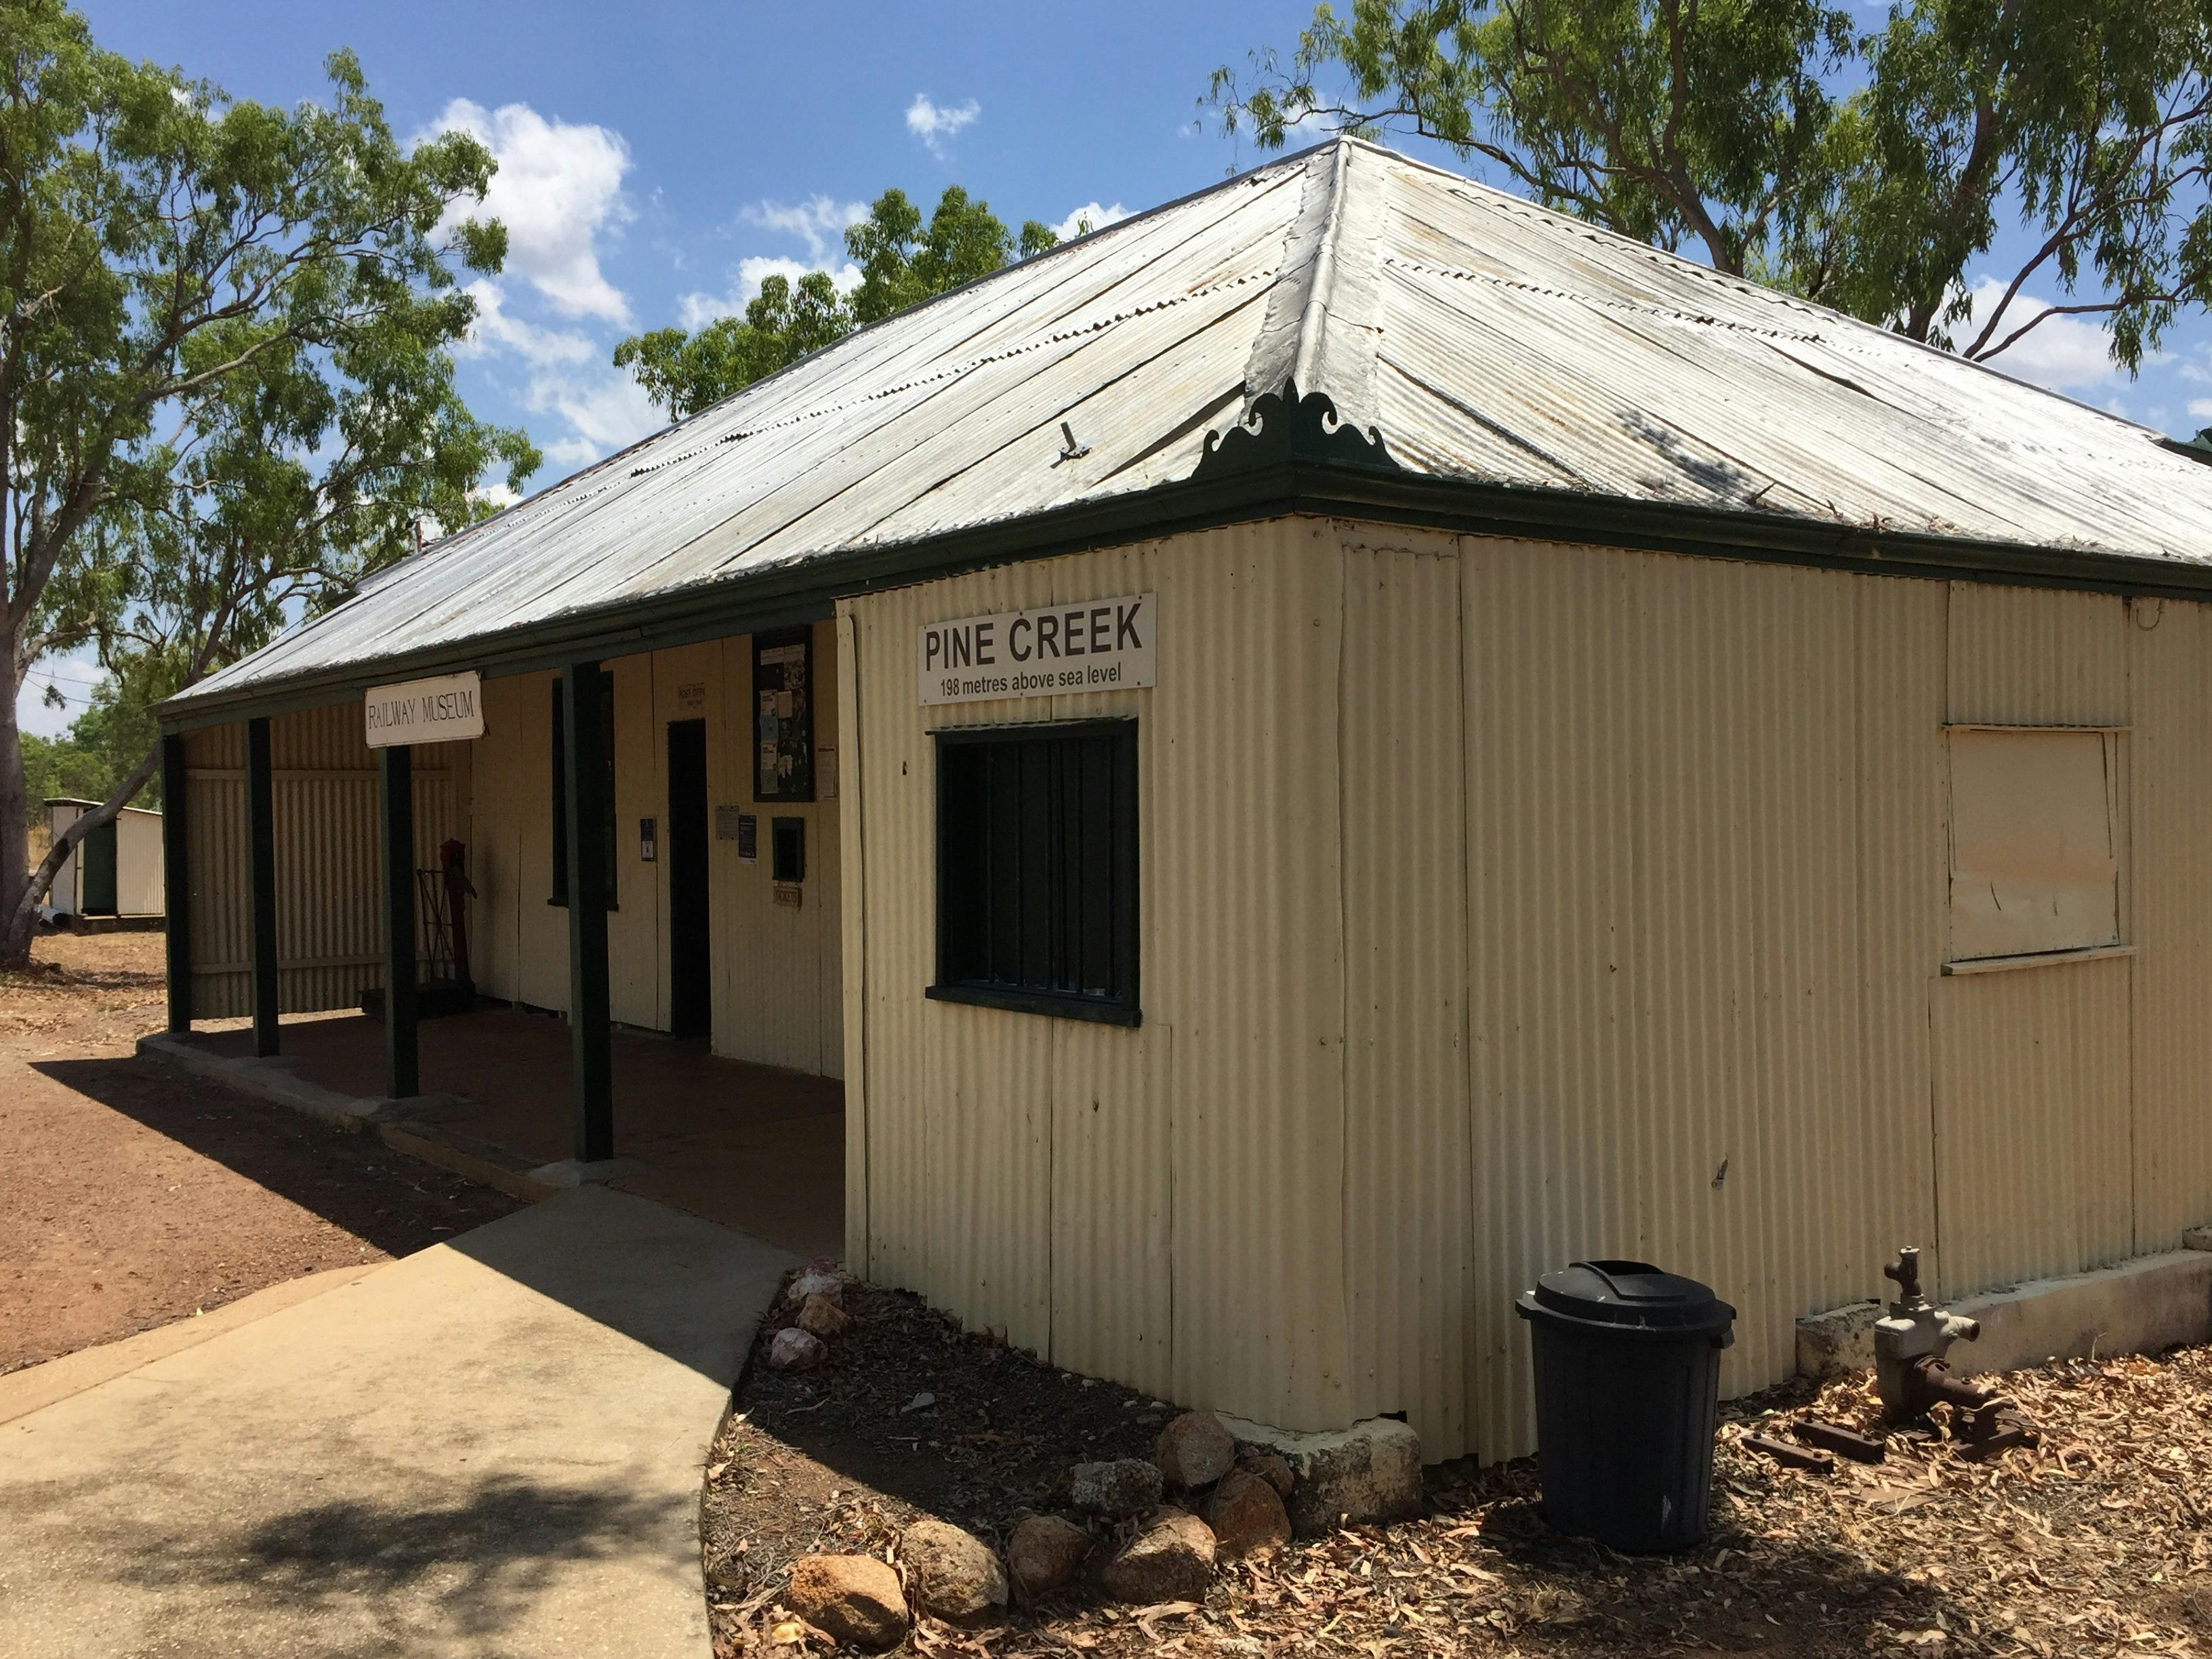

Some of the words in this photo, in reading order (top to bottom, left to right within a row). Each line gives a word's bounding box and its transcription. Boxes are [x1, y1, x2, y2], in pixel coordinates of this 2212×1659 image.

[926, 623, 995, 672] PINE
[1009, 602, 1142, 661] CREEK
[941, 678, 960, 697] 198
[962, 674, 1008, 695] metres
[1012, 672, 1054, 691] above
[1059, 671, 1083, 687] sea
[1087, 661, 1121, 683] level
[368, 698, 415, 729] RAILWAY
[422, 691, 474, 722] MUSEUM
